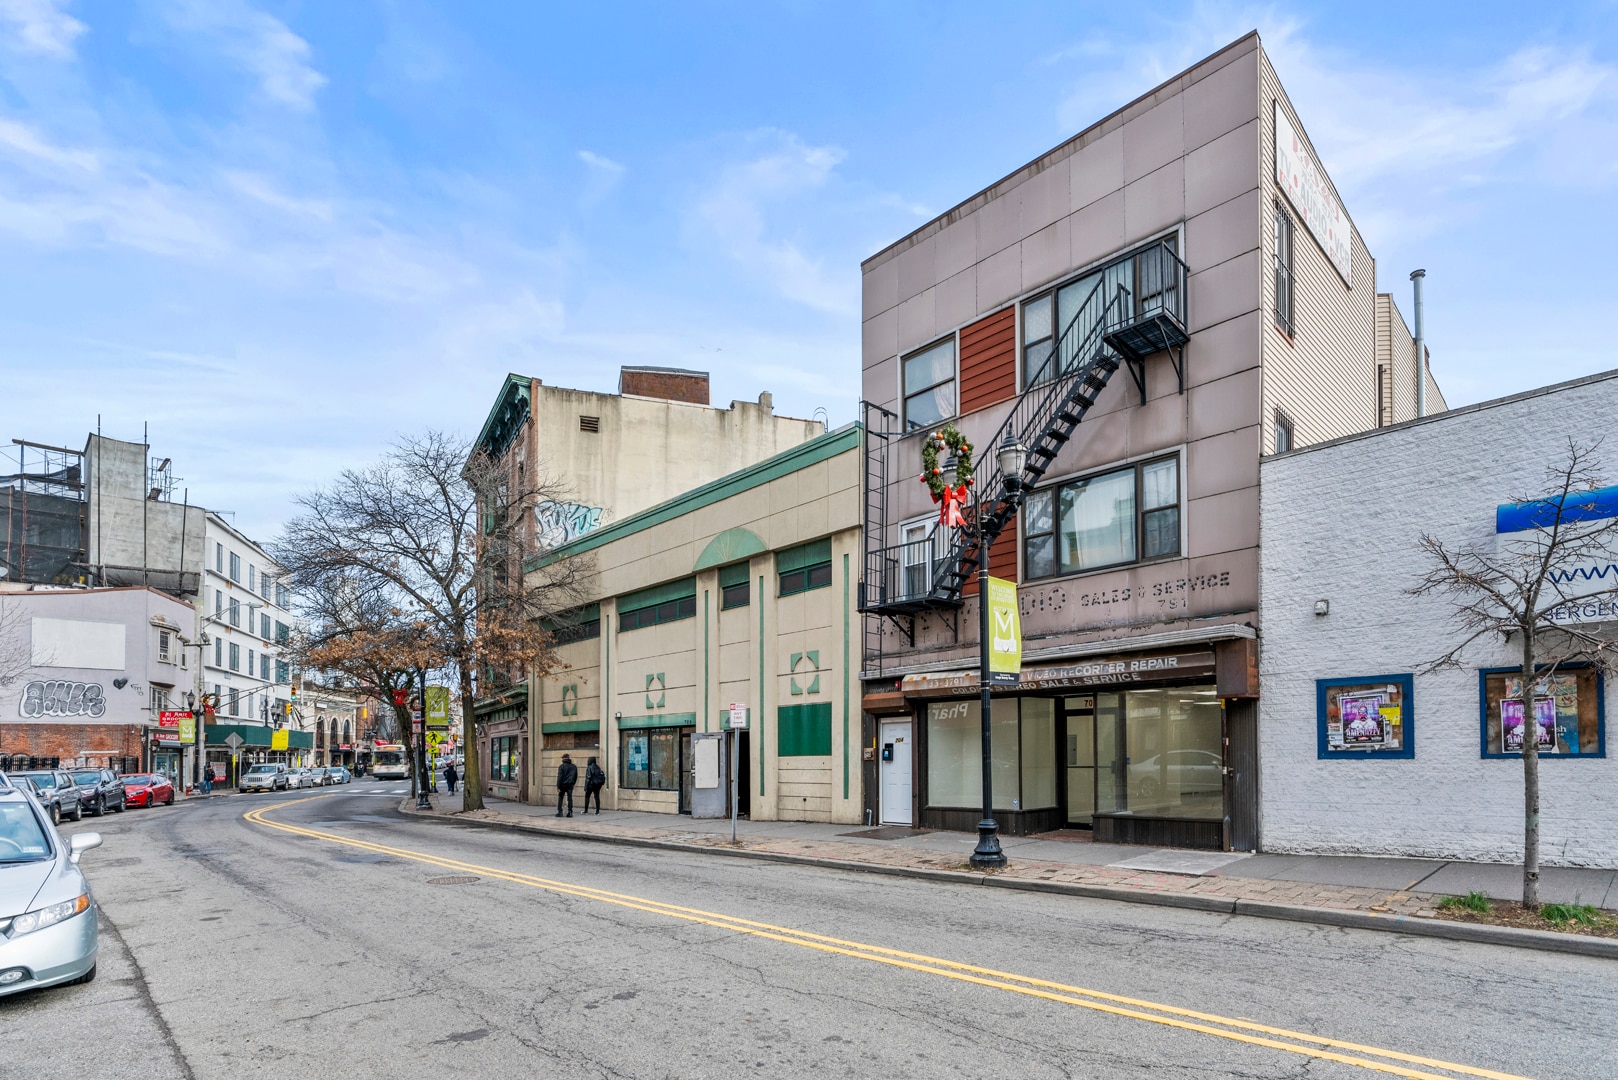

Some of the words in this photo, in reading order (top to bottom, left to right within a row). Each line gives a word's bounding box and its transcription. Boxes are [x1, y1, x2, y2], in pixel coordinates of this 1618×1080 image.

[1081, 588, 1132, 607] SALES
[1153, 571, 1230, 596] SERVICE
[1130, 657, 1178, 671] REPAIR
[1039, 678, 1070, 688] SALE
[1083, 672, 1141, 684] SERVICE
